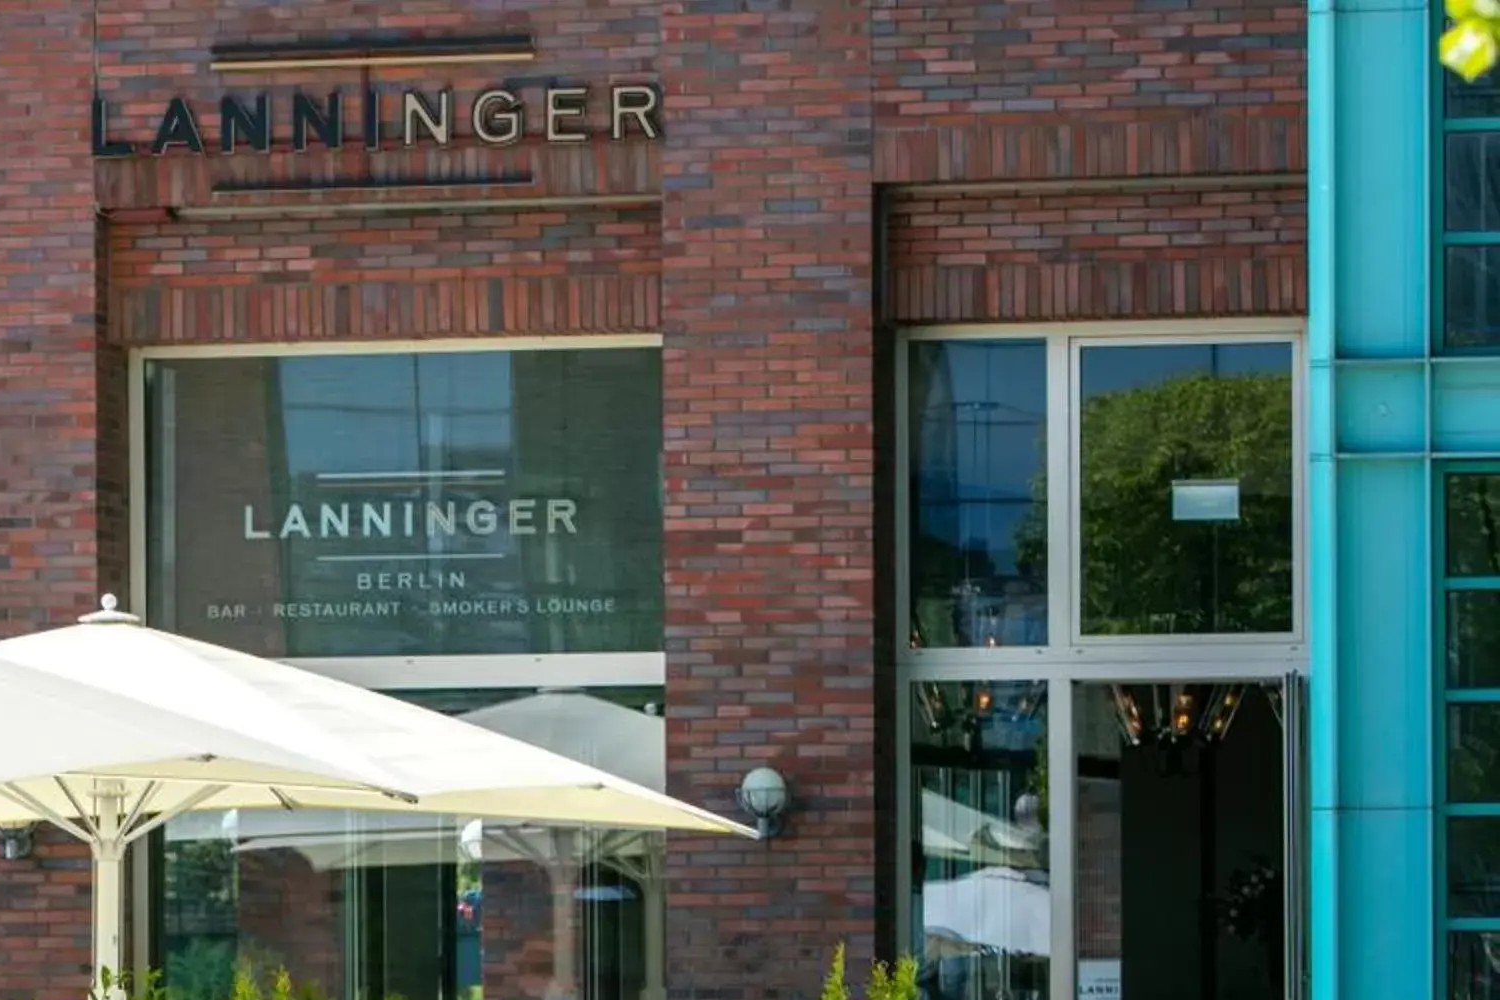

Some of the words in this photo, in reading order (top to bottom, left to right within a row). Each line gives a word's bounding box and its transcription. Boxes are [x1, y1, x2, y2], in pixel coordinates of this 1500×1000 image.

[92, 84, 663, 157] LANNINGER
[243, 499, 578, 540] LANNINGER
[357, 572, 465, 590] BERLIN
[207, 604, 246, 619] BAR
[273, 602, 401, 617] RESTAURANT
[536, 598, 616, 614] LOUNGE
